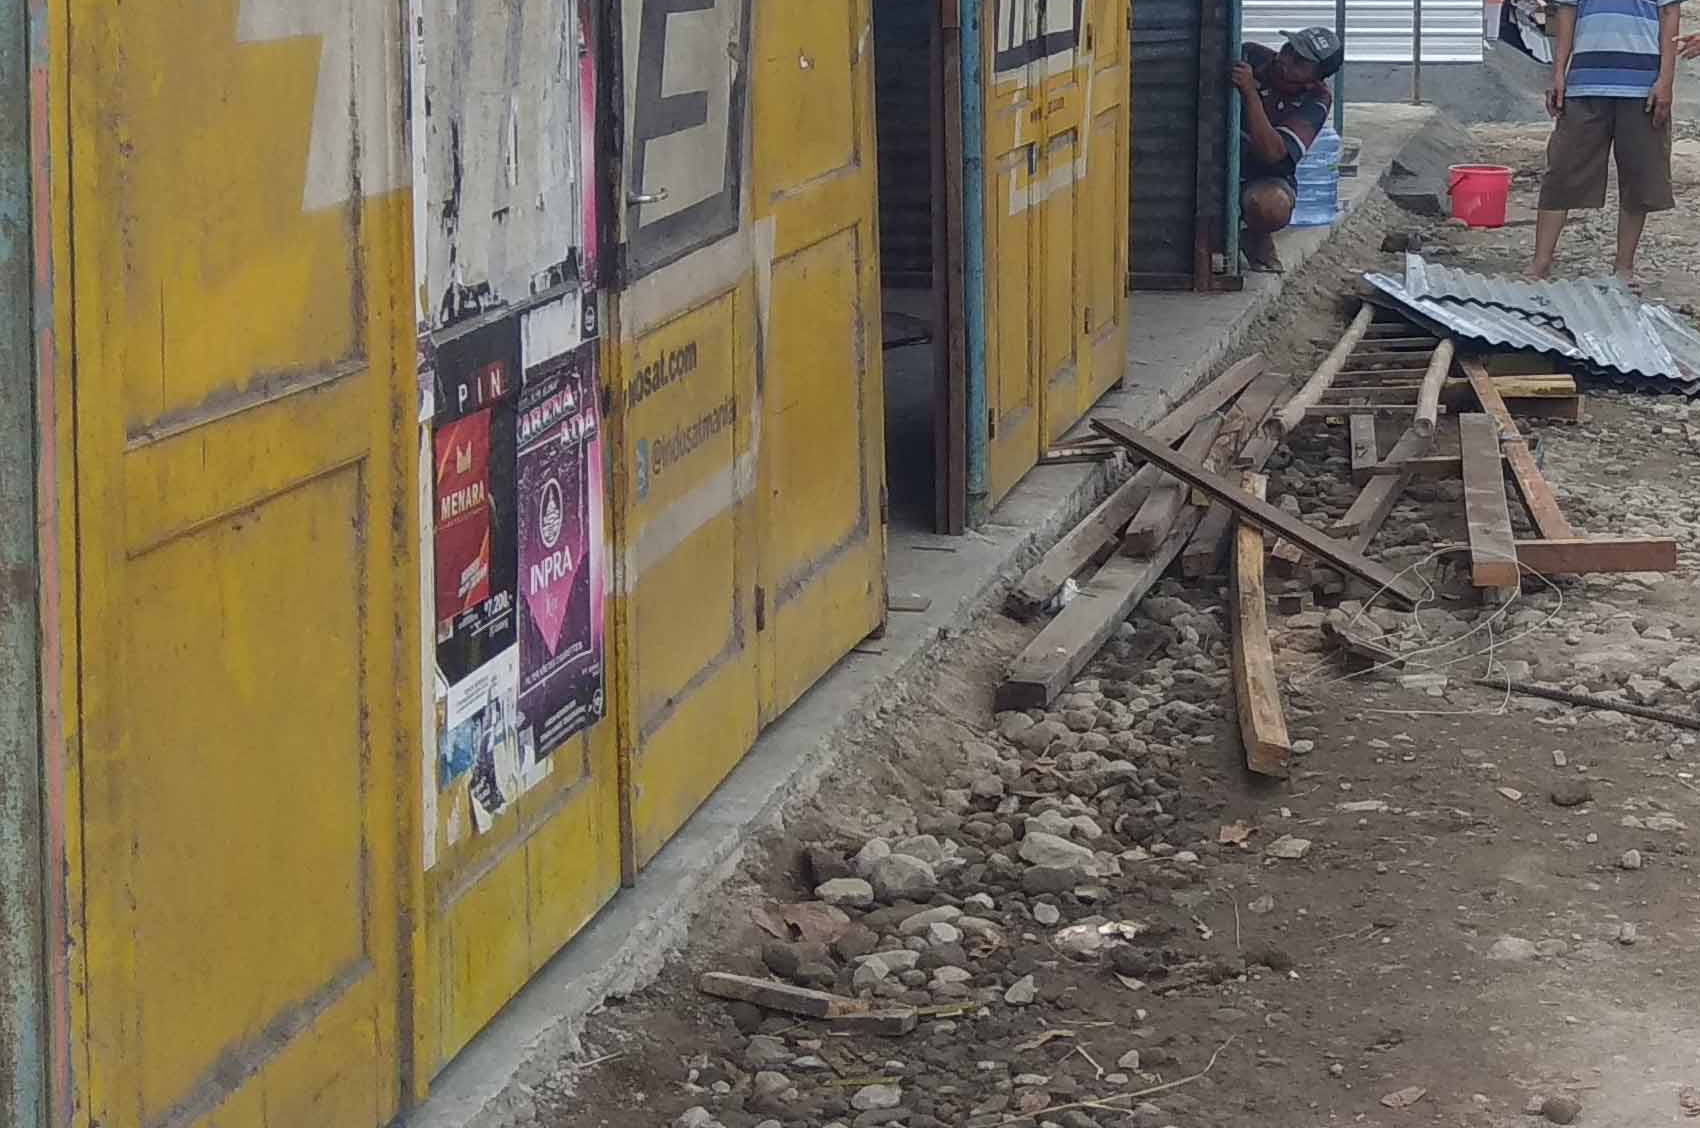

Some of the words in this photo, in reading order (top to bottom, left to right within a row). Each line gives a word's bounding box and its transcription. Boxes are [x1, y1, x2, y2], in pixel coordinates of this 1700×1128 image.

[458, 368, 501, 413] PIN
[441, 480, 485, 522] MENARA
[530, 545, 573, 596] INPRA
